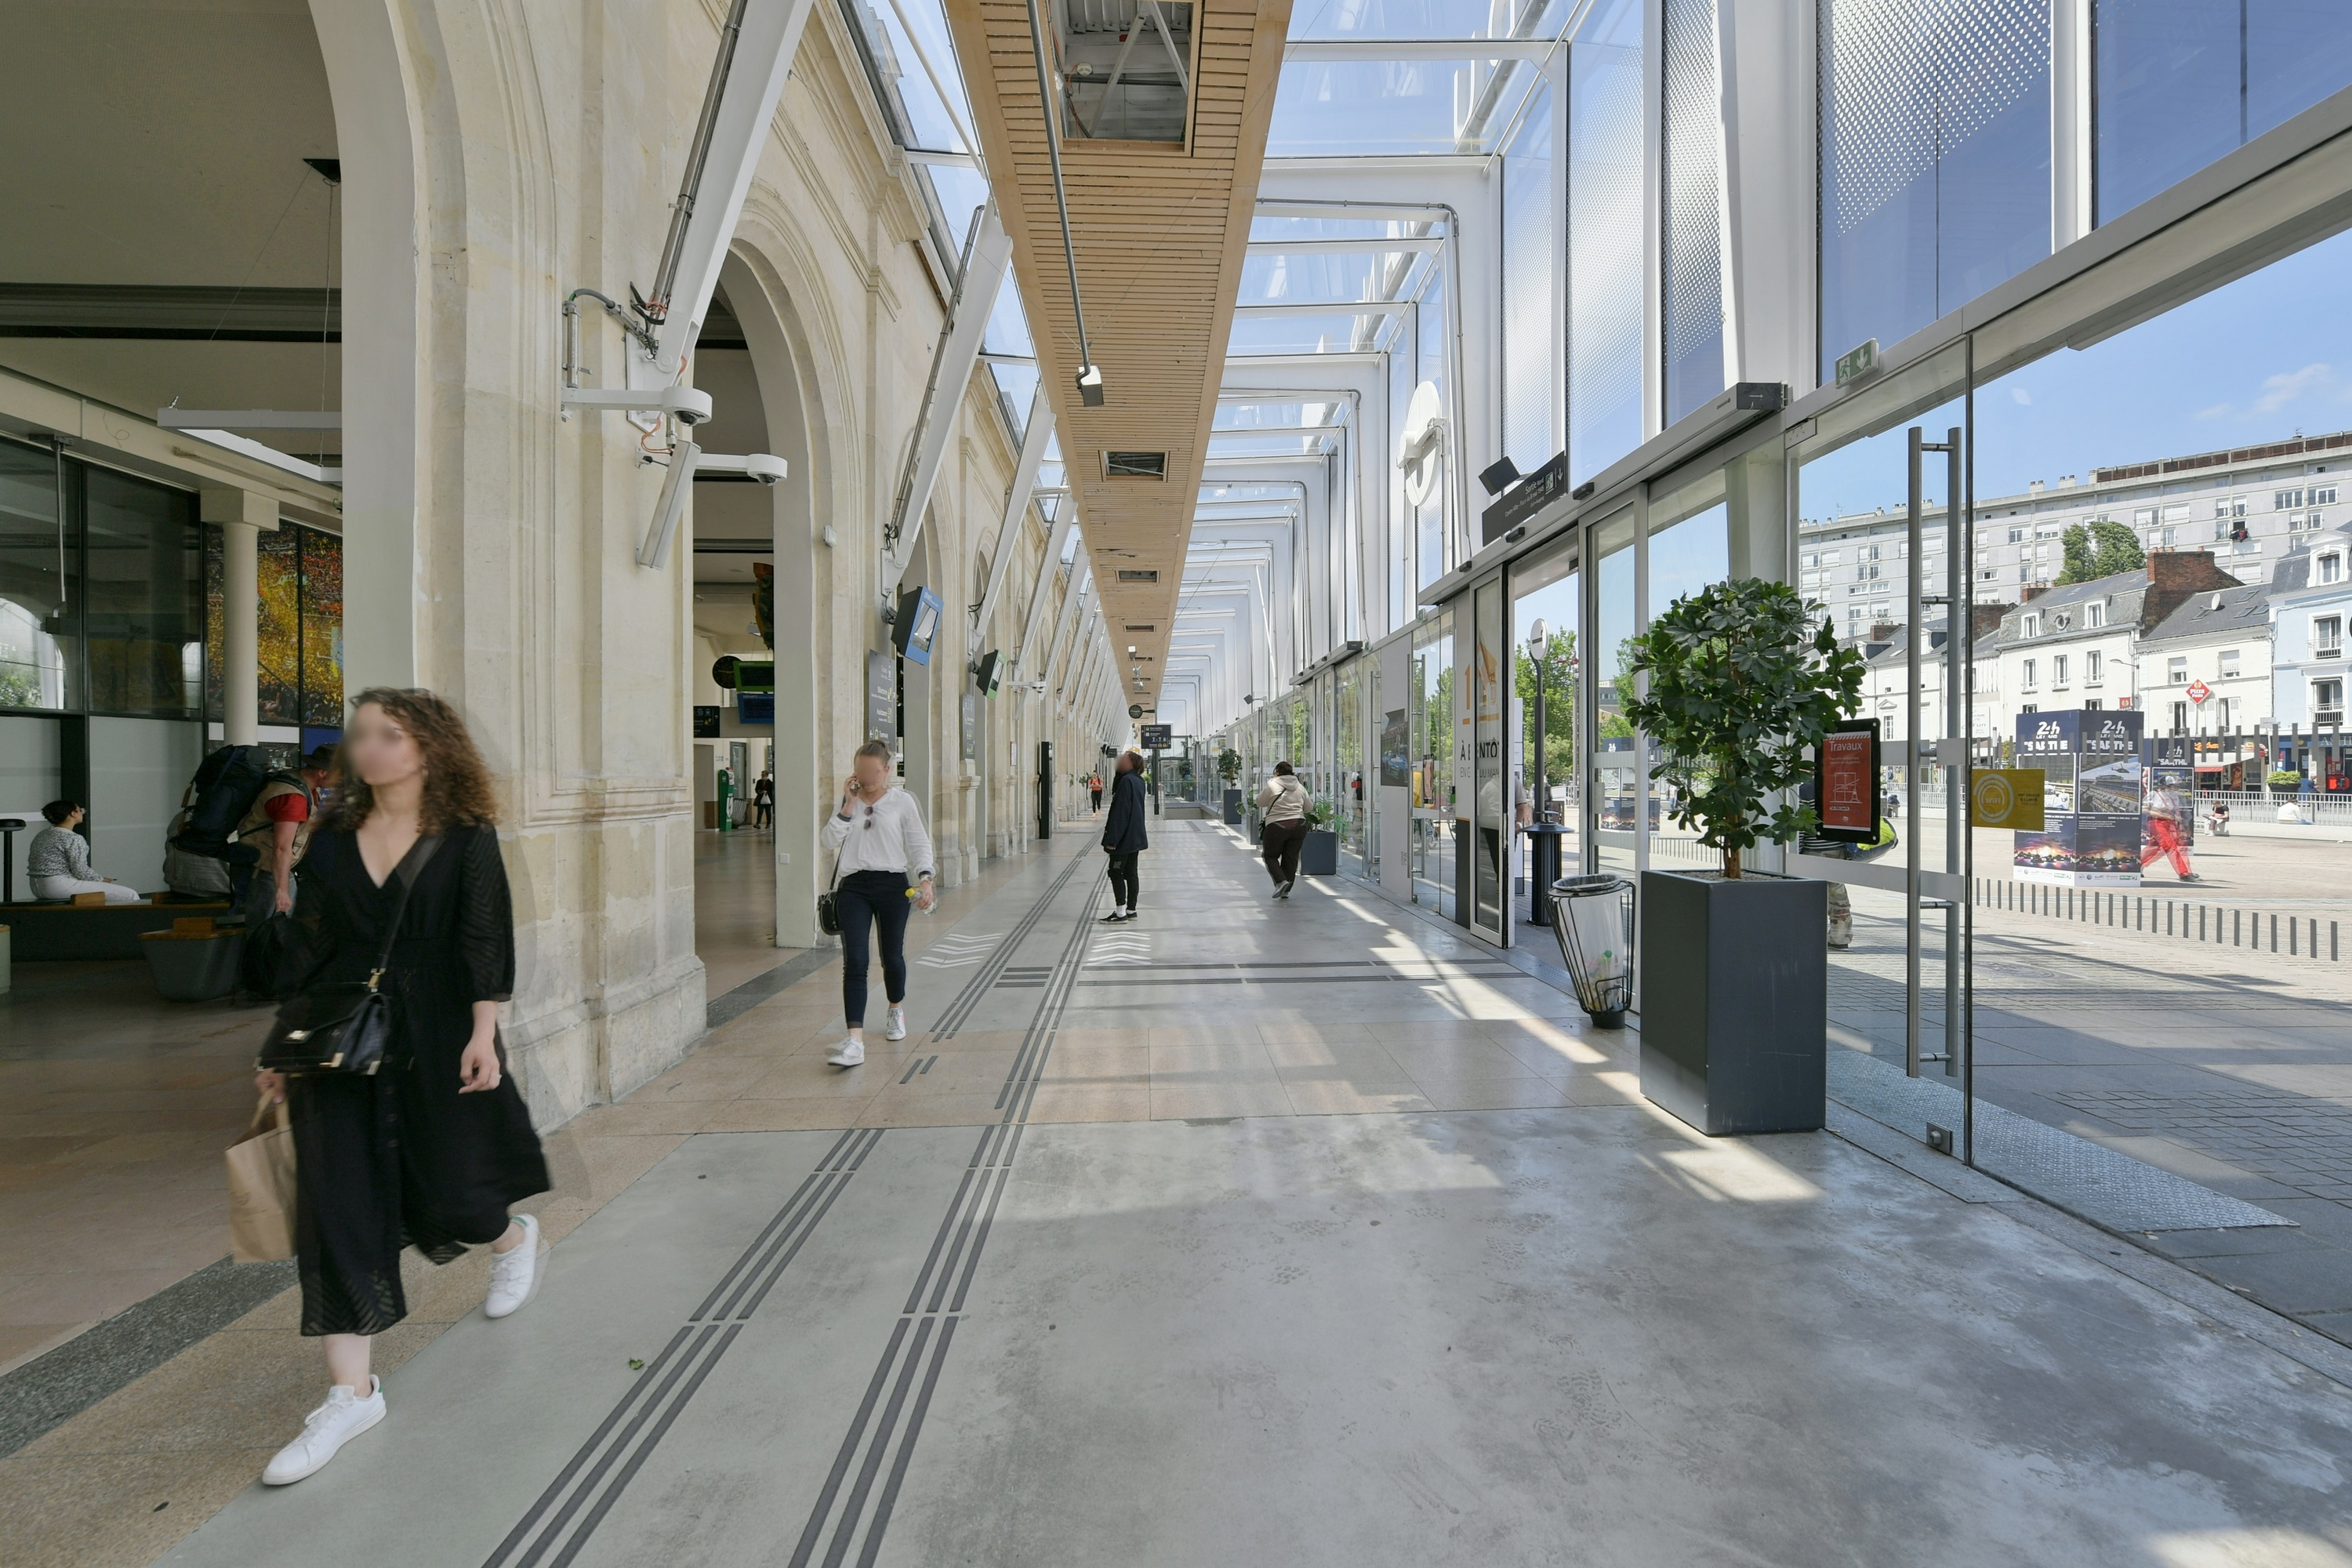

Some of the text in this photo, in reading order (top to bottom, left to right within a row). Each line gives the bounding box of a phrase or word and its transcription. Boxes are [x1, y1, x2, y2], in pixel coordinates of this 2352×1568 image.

[1526, 481, 1537, 495] Sortie
[1460, 739, 1466, 761] À
[1829, 741, 1863, 752] Travaux
[1487, 768, 1500, 779] MAN
